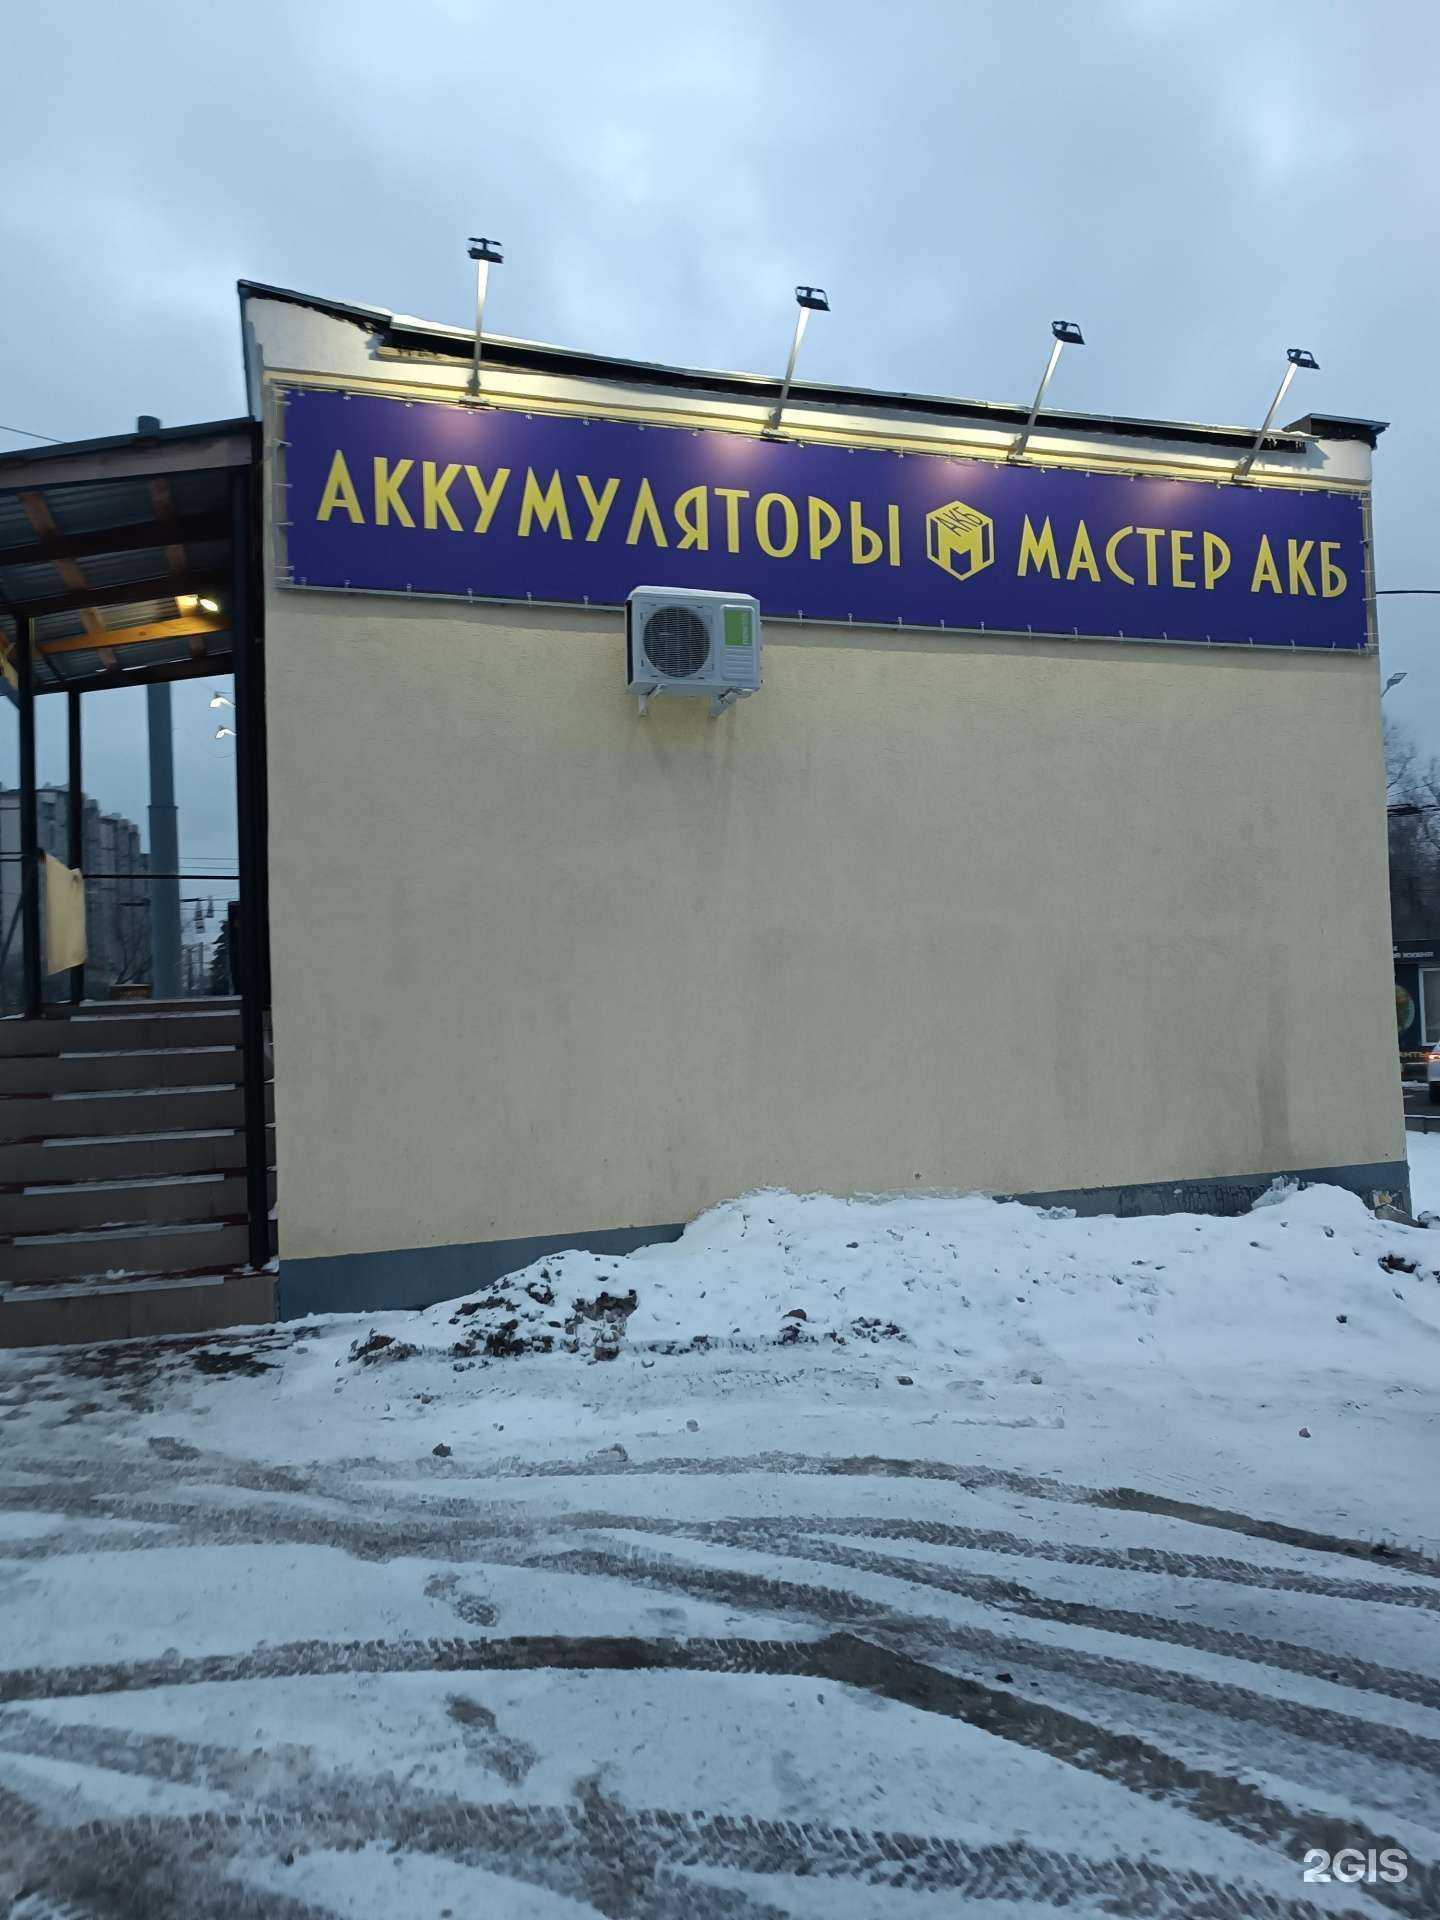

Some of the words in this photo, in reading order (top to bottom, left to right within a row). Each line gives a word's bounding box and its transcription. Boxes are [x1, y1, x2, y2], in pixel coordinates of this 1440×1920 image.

[317, 450, 902, 567] АККУМУЛЯТОРЫ
[1017, 514, 1232, 590] МАСТЕР
[1249, 534, 1348, 599] АКБ
[934, 505, 983, 557] АКБ
